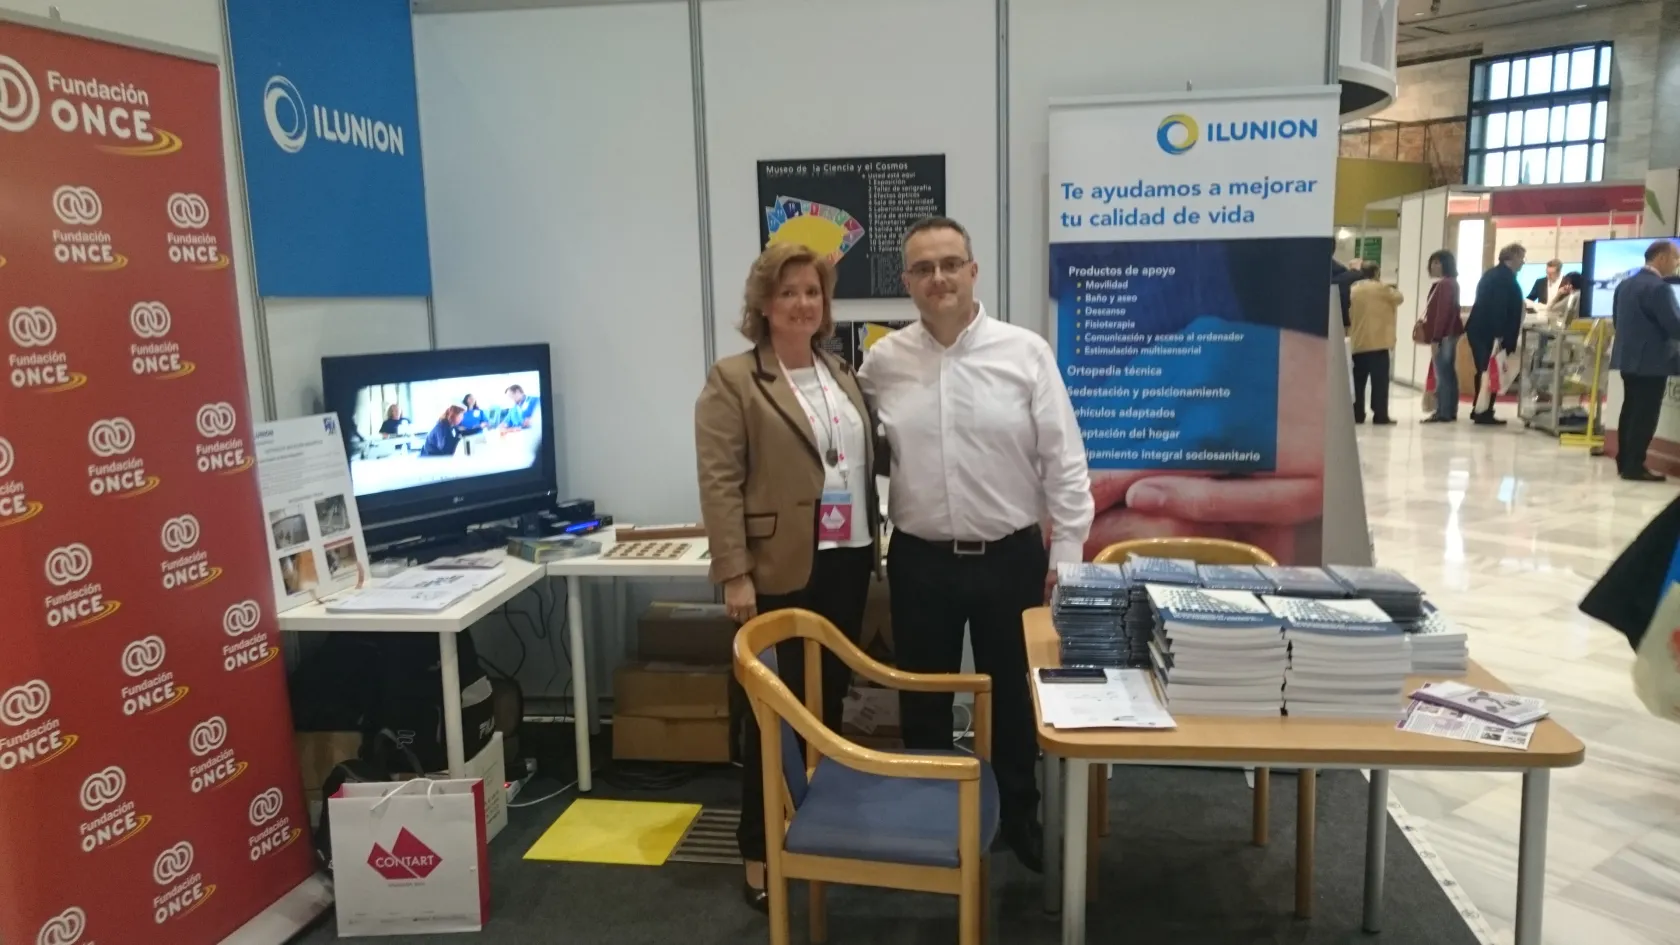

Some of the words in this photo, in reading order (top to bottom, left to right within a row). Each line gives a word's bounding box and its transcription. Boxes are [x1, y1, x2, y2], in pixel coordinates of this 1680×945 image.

[47, 70, 149, 107] Fundación
[51, 99, 154, 142] ONCE
[313, 104, 404, 156] ILUNION
[1208, 118, 1318, 142] ILUNION
[766, 165, 794, 174] Museo
[796, 164, 807, 173] de
[812, 164, 820, 172] la
[823, 163, 854, 172] Ciencia
[857, 164, 862, 172] y
[864, 162, 872, 170] el
[876, 162, 908, 170] Cosmos
[1060, 183, 1084, 200] Te
[1091, 180, 1202, 204] ayudamos
[1208, 184, 1222, 196] a
[1229, 176, 1318, 199] mejorar
[1060, 212, 1082, 227] tu
[1090, 208, 1165, 226] calidad
[1174, 206, 1201, 225] de
[1209, 205, 1255, 224] vida
[53, 230, 112, 244] Fundación
[168, 233, 216, 245] Fundación
[54, 246, 114, 264] ONCE
[168, 246, 218, 264] ONCE
[1068, 266, 1122, 277] Productos
[1125, 265, 1139, 276] de
[1142, 266, 1176, 279] apoyo
[1085, 280, 1129, 290] Movilidad
[1085, 294, 1108, 303] Baño
[1110, 296, 1115, 304] y
[1085, 307, 1126, 316] Descanso
[1085, 320, 1135, 331] Fisioterapia
[1084, 332, 1145, 342] Comunicación
[1146, 335, 1153, 343] y
[1154, 334, 1184, 342] acceso
[1186, 332, 1194, 342] al
[1196, 332, 1244, 342] ordenador
[9, 351, 66, 367] Fundación
[131, 341, 180, 356] Fundación
[1084, 346, 1139, 356] Estimulación
[1141, 345, 1202, 356] multisensorial
[132, 355, 182, 374] ONCE
[1067, 365, 1122, 379] Ortopedia
[1124, 364, 1162, 376] técnica
[10, 364, 70, 388] ONCE
[1132, 388, 1139, 399] y
[1142, 388, 1231, 399] posicionamiento
[1075, 407, 1116, 418] ehículos
[1119, 407, 1176, 419] adaptados
[1081, 428, 1126, 440] aptación
[1129, 428, 1146, 439] del
[1148, 428, 1180, 441] hogar
[196, 438, 244, 455] Fundación
[1142, 449, 1183, 462] integral
[1185, 450, 1260, 462] sociosanitario
[88, 458, 143, 477] Fundación
[197, 452, 245, 472] ONCE
[90, 474, 146, 496] ONCE
[161, 551, 208, 572] Fundación
[163, 560, 210, 588] ONCE
[45, 582, 102, 609] Fundación
[47, 593, 104, 628] ONCE
[223, 632, 268, 656] Fundación
[224, 643, 270, 672] ONCE
[121, 670, 174, 698] Fundación
[123, 682, 176, 716] ONCE
[0, 718, 60, 751] Fundación
[0, 730, 63, 770] ONCE
[189, 748, 235, 778] Fundación
[191, 760, 238, 793] ONCE
[79, 800, 134, 835] Fundación
[82, 812, 138, 852] ONCE
[248, 816, 289, 846] Fundación
[250, 828, 292, 860] ONCE
[376, 855, 434, 868] CONTART
[153, 872, 202, 908] Fundación
[155, 883, 204, 924] ONCE
